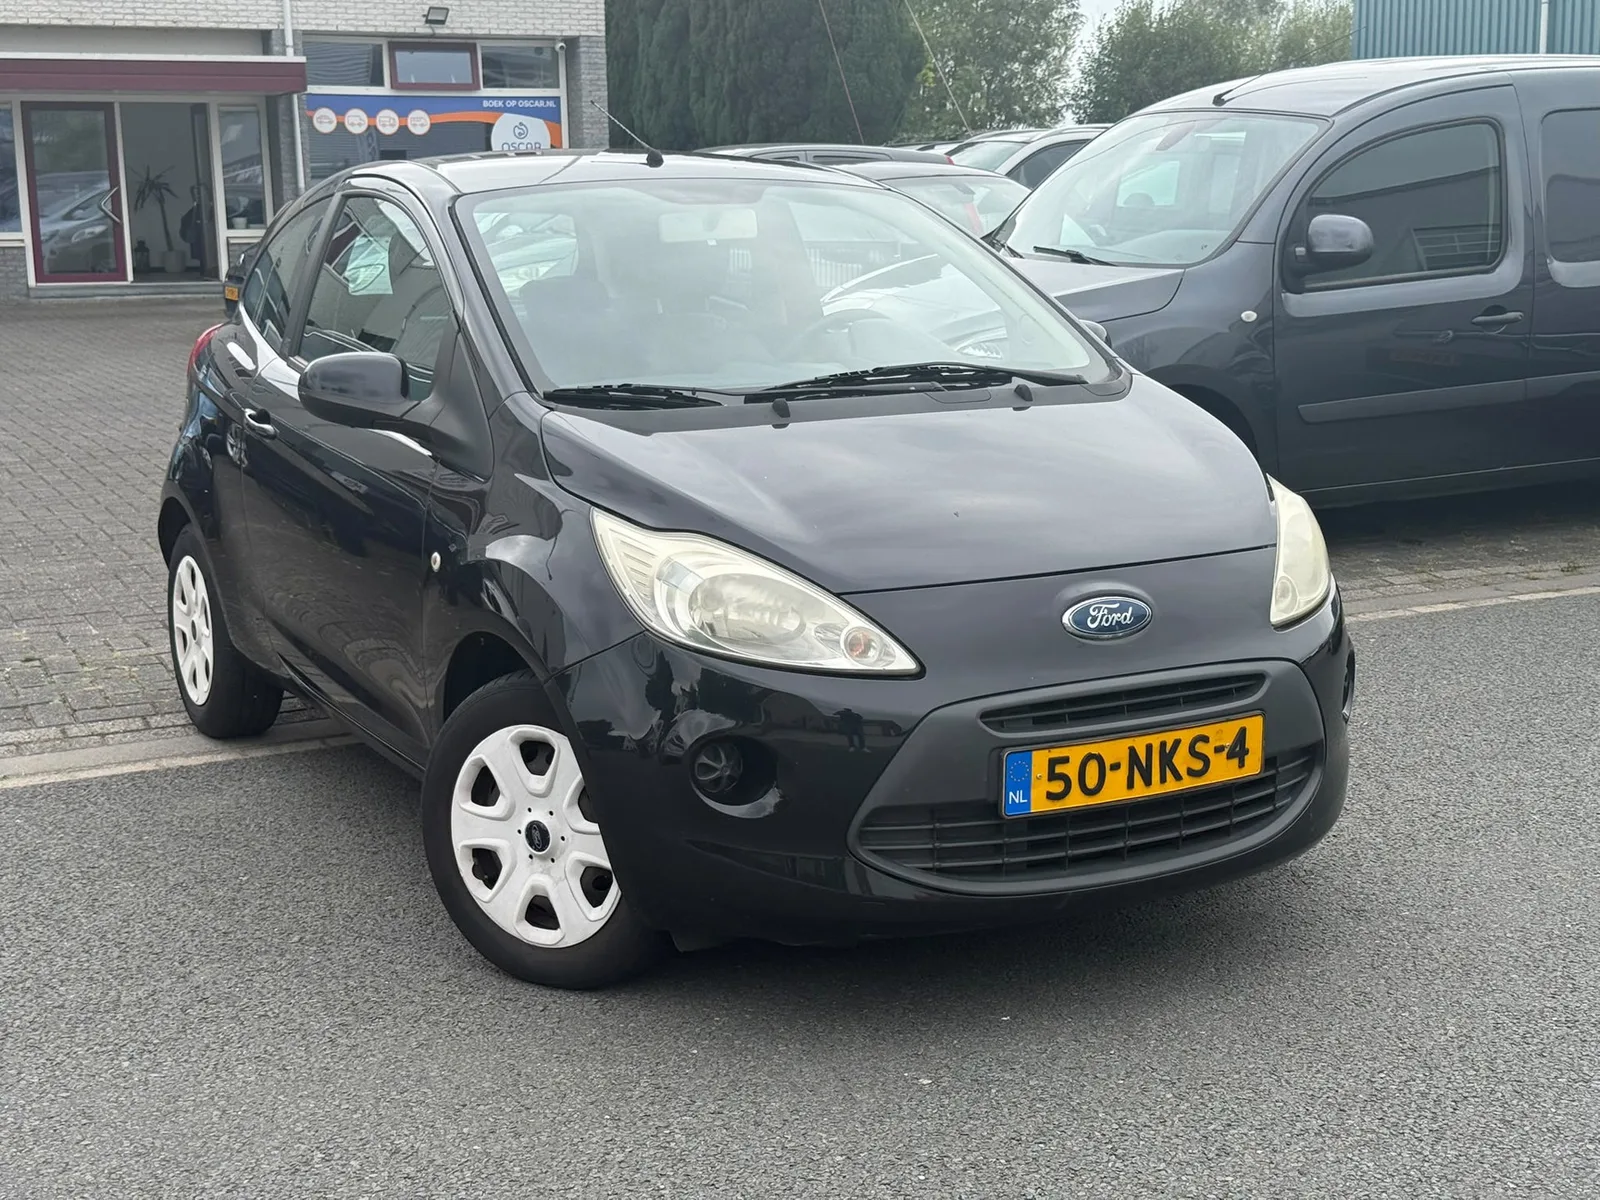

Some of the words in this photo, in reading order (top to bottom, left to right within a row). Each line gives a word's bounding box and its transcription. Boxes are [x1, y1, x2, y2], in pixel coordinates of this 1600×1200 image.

[483, 100, 504, 108] BOEK
[505, 100, 517, 108] OP
[518, 100, 556, 108] OSCAR.NL
[1087, 603, 1134, 629] Ford
[1045, 725, 1250, 801] 50-NKS-4
[1008, 791, 1028, 805] NL
